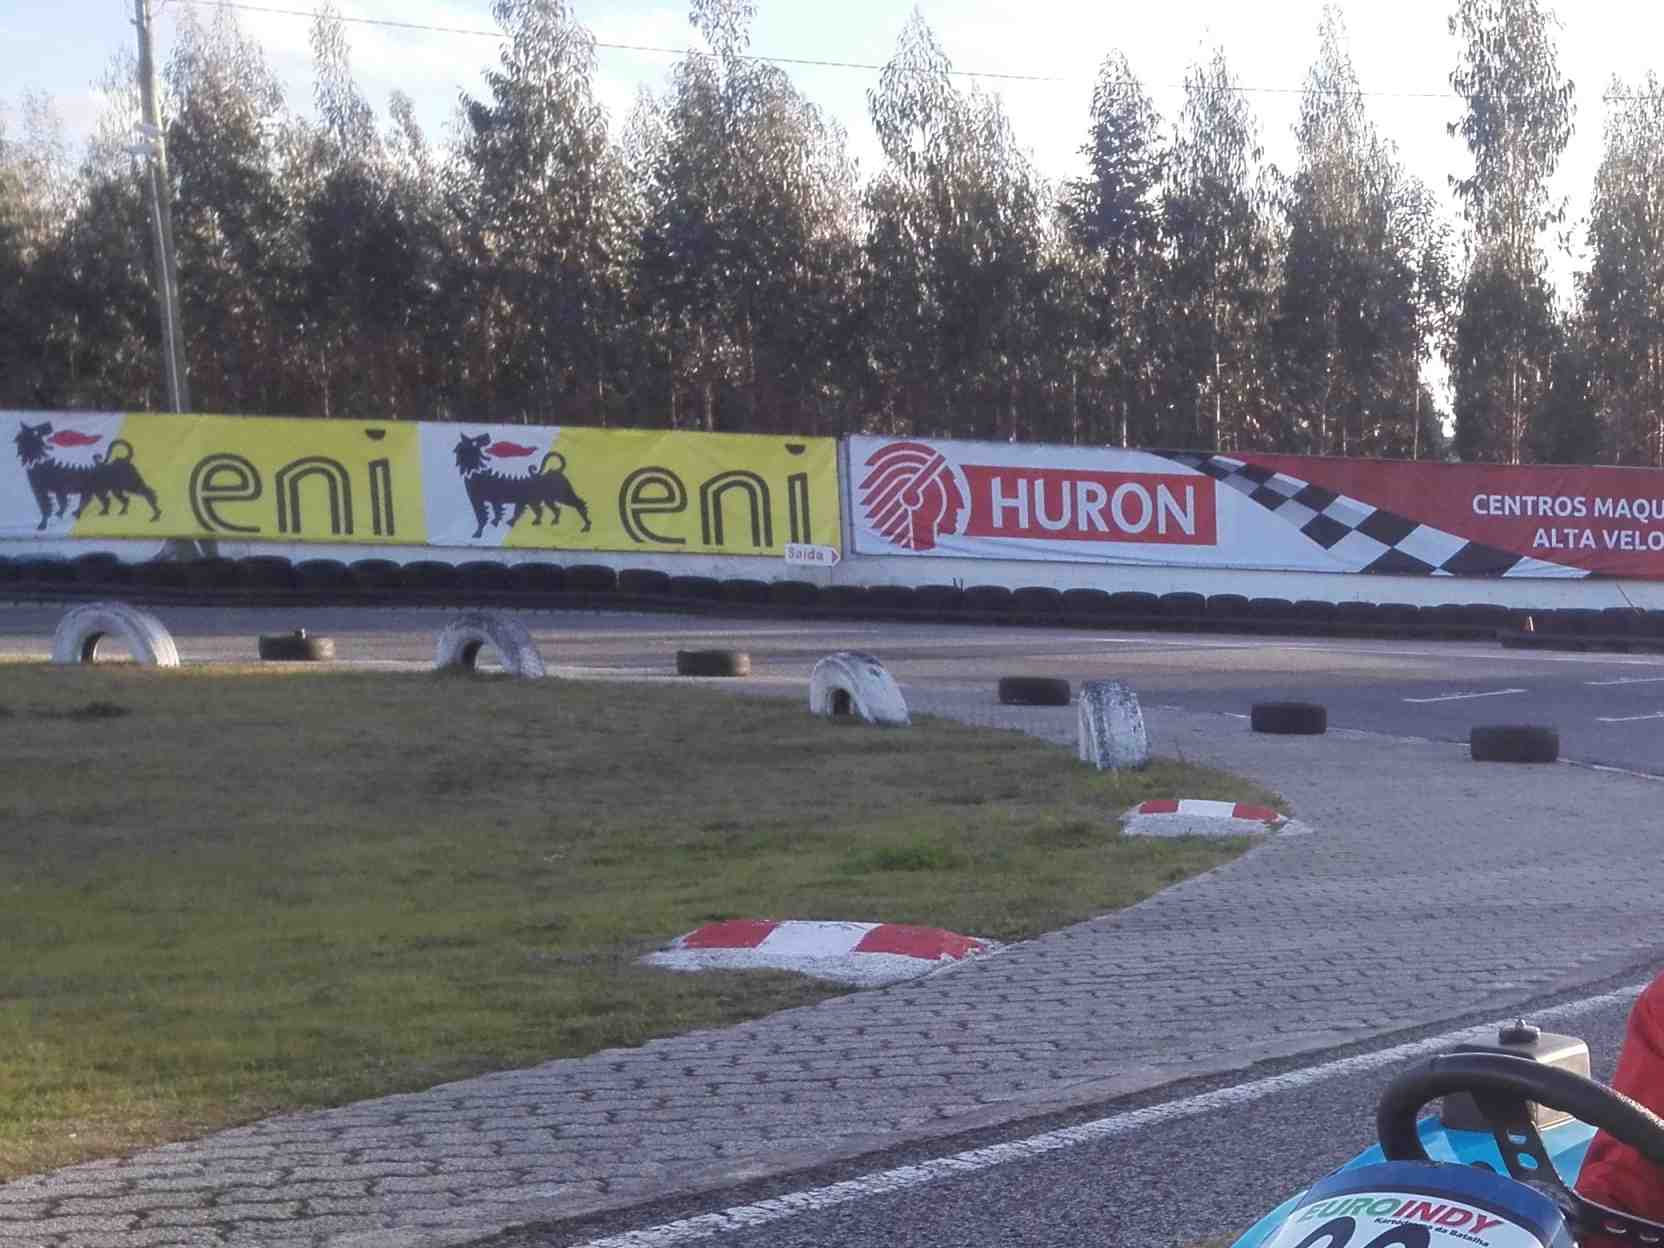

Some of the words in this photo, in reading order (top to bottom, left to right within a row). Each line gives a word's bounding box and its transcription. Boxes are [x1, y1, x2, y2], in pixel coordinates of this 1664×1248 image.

[189, 428, 395, 536] eni
[618, 444, 812, 546] eni
[991, 476, 1196, 536] HURON
[1473, 494, 1587, 518] CENTROS
[1532, 527, 1597, 550] ALTA
[1302, 1197, 1503, 1235] EUROINDY
